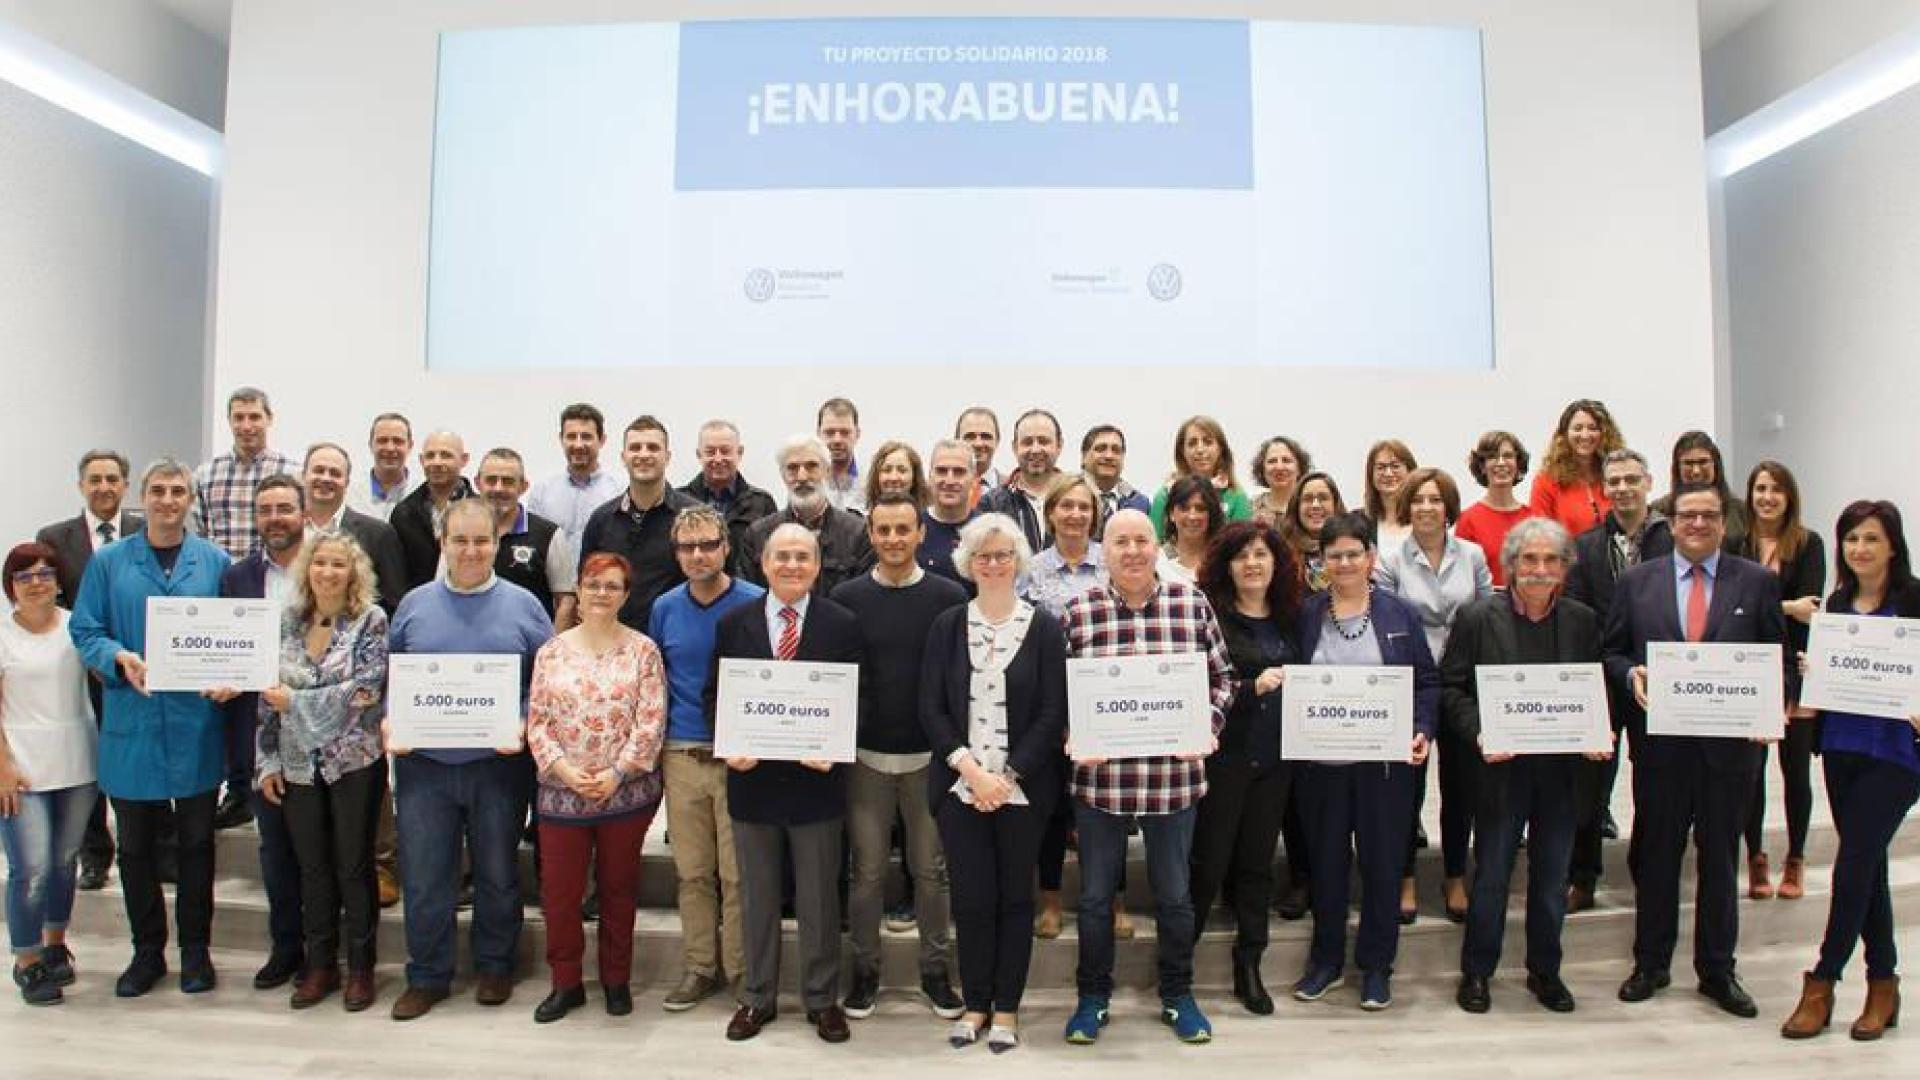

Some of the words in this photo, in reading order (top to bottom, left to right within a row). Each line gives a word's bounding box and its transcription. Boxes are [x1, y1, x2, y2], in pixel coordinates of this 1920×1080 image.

[824, 47, 847, 64] TU
[851, 47, 951, 64] PROYECTO
[955, 47, 1058, 64] SOLIDARIO
[1061, 47, 1108, 64] 2018
[748, 82, 1180, 135] ¡ENHORABUENA!
[171, 636, 212, 649] 5.000
[215, 639, 255, 649] euros
[1829, 656, 1870, 670] 5.000
[1872, 661, 1914, 676] euros
[1672, 682, 1714, 695] 5.000
[1717, 685, 1759, 697] euros
[413, 695, 453, 707] 5.000
[456, 697, 496, 707] euros
[1096, 699, 1138, 714] 5.000
[1142, 698, 1183, 712] euros
[1504, 702, 1543, 714] 5.000
[1546, 703, 1584, 714] euros
[743, 701, 786, 715] 5.000
[789, 705, 830, 718] euros
[1306, 706, 1347, 719] 5.000
[1350, 708, 1389, 719] euros
